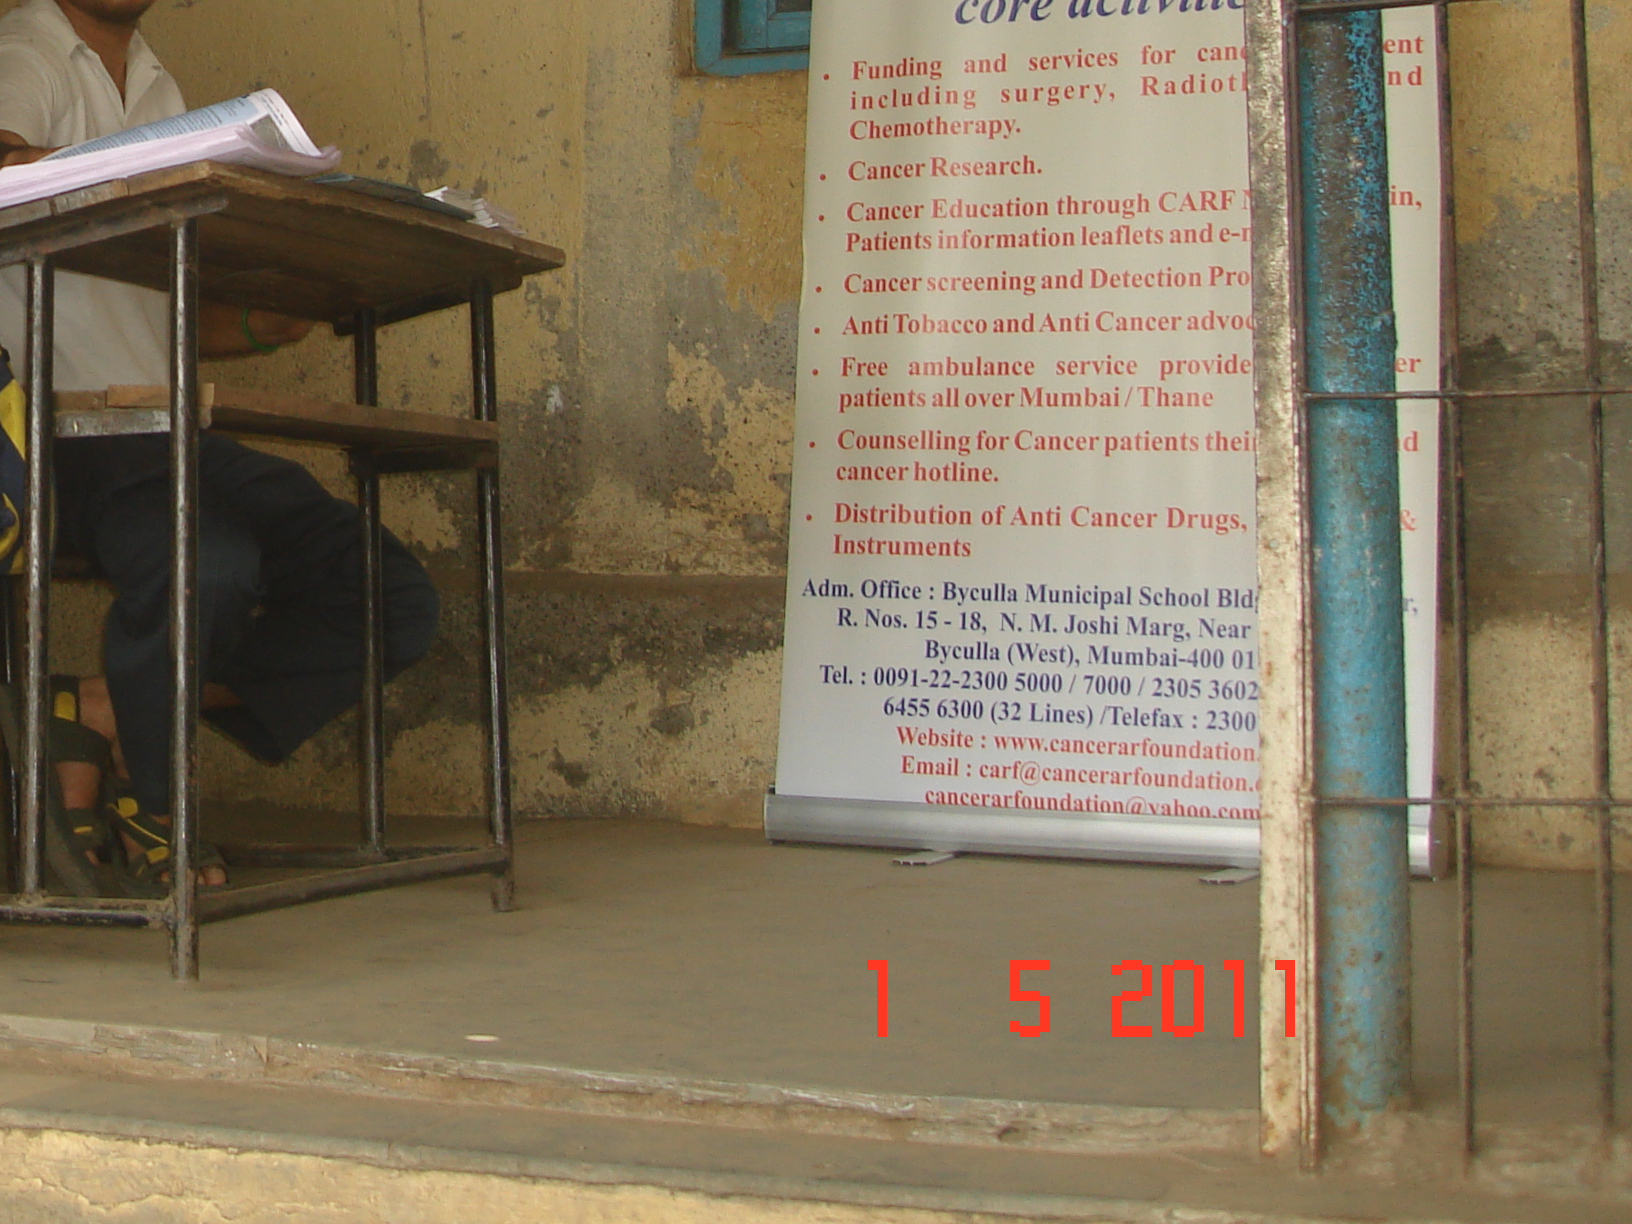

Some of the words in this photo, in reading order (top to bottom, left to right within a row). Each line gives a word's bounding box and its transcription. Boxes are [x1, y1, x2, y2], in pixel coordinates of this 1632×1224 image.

[851, 57, 942, 81] Funding
[963, 53, 1007, 74] and
[1029, 47, 1119, 72] services
[1140, 45, 1176, 66] for
[850, 86, 977, 110] including
[1001, 79, 1115, 106] surgery,
[849, 117, 1021, 141] Chemotherapy.
[847, 160, 926, 181] Cancer
[930, 154, 1043, 178] Research.
[846, 202, 924, 222] Cancer
[931, 197, 1049, 220] Education
[1056, 193, 1150, 220] through
[1158, 189, 1236, 213] CARF
[845, 232, 932, 253] Patients
[937, 226, 1076, 250] information
[1081, 225, 1164, 246] leaflets
[1169, 224, 1212, 244] and
[843, 274, 922, 294] Cancer
[927, 271, 1036, 296] screening
[1040, 269, 1084, 290] and
[1089, 267, 1201, 289] Detection
[842, 316, 889, 336] Anti
[893, 314, 988, 334] Tobacco
[993, 313, 1034, 334] and
[1038, 312, 1090, 333] Anti
[1095, 310, 1181, 332] Cancer
[841, 356, 888, 376] Free
[908, 357, 1035, 377] ambulance
[1056, 355, 1137, 375] service
[838, 387, 926, 413] patients
[932, 387, 959, 408] all
[964, 390, 1015, 408] over
[1020, 387, 1120, 408] Mumbai
[1137, 386, 1214, 408] Thane
[837, 429, 971, 456] Counselling
[976, 430, 1009, 451] for
[1013, 430, 1099, 451] Cancer
[1103, 431, 1199, 456] patients
[836, 463, 909, 482] cancer
[914, 462, 999, 482] hotline.
[834, 503, 972, 527] Distribution
[981, 505, 1006, 526] of
[1010, 506, 1061, 527] Anti
[1070, 506, 1158, 529] Cancer
[1166, 507, 1248, 536] Drugs,
[833, 534, 971, 558] Instruments
[802, 578, 855, 600] Adm.
[861, 579, 921, 601] Office
[942, 581, 1018, 606] Byculla
[1025, 584, 1132, 610] Municipal
[1139, 586, 1209, 608] School
[838, 607, 858, 628] R.
[865, 609, 907, 630] Nos.
[915, 610, 938, 630] 15
[959, 611, 987, 633] 18,
[999, 613, 1022, 633] N.
[1029, 613, 1058, 634] M.
[1064, 613, 1118, 636] Joshi
[1126, 617, 1191, 642] Marg,
[1198, 619, 1251, 640] Near
[925, 639, 1000, 665] Byculla
[1007, 640, 1080, 667] (West),
[1087, 645, 1224, 670] Mumbai-400
[820, 665, 853, 685] Tel.
[874, 667, 1008, 692] 0091-22-2300
[1015, 672, 1063, 695] 5000
[1084, 675, 1130, 697] 7000
[1152, 677, 1201, 700] 2305
[1208, 680, 1259, 701] 3602
[884, 697, 929, 718] 6455
[937, 698, 983, 720] 6300
[990, 699, 1021, 724] (32
[1030, 702, 1093, 728] Lines)
[1206, 711, 1256, 732] 2300
[897, 726, 973, 749] Website
[901, 755, 959, 777] Email
